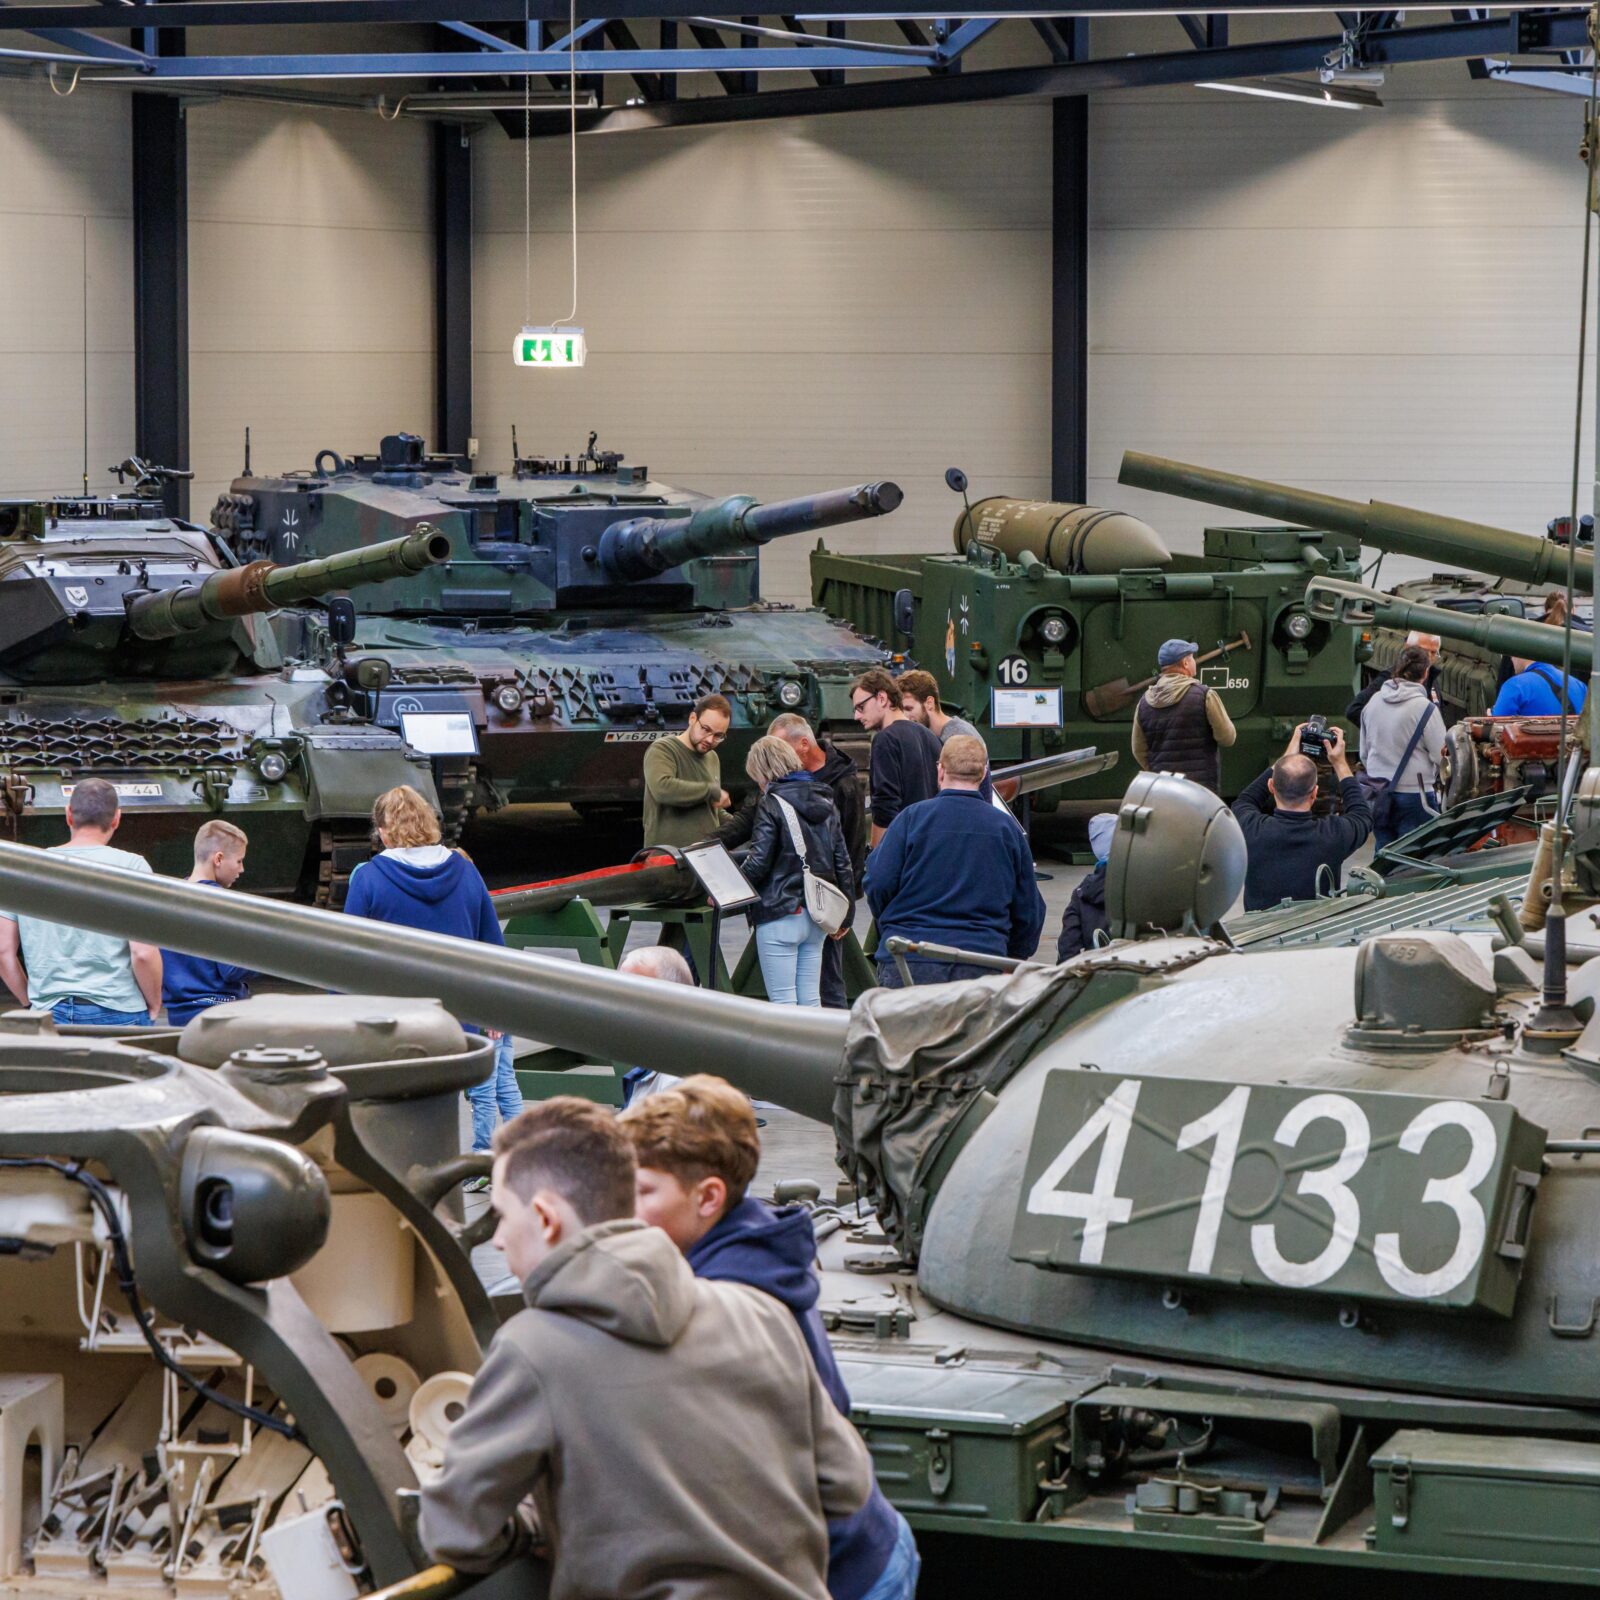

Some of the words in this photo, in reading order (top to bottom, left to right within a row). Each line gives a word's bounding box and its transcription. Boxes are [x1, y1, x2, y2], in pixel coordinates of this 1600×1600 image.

[998, 658, 1028, 685] 16
[1228, 678, 1250, 689] 650
[616, 732, 625, 741] Y
[631, 732, 658, 741] 678
[133, 785, 161, 795] 441
[1025, 1078, 1497, 1298] 4133
